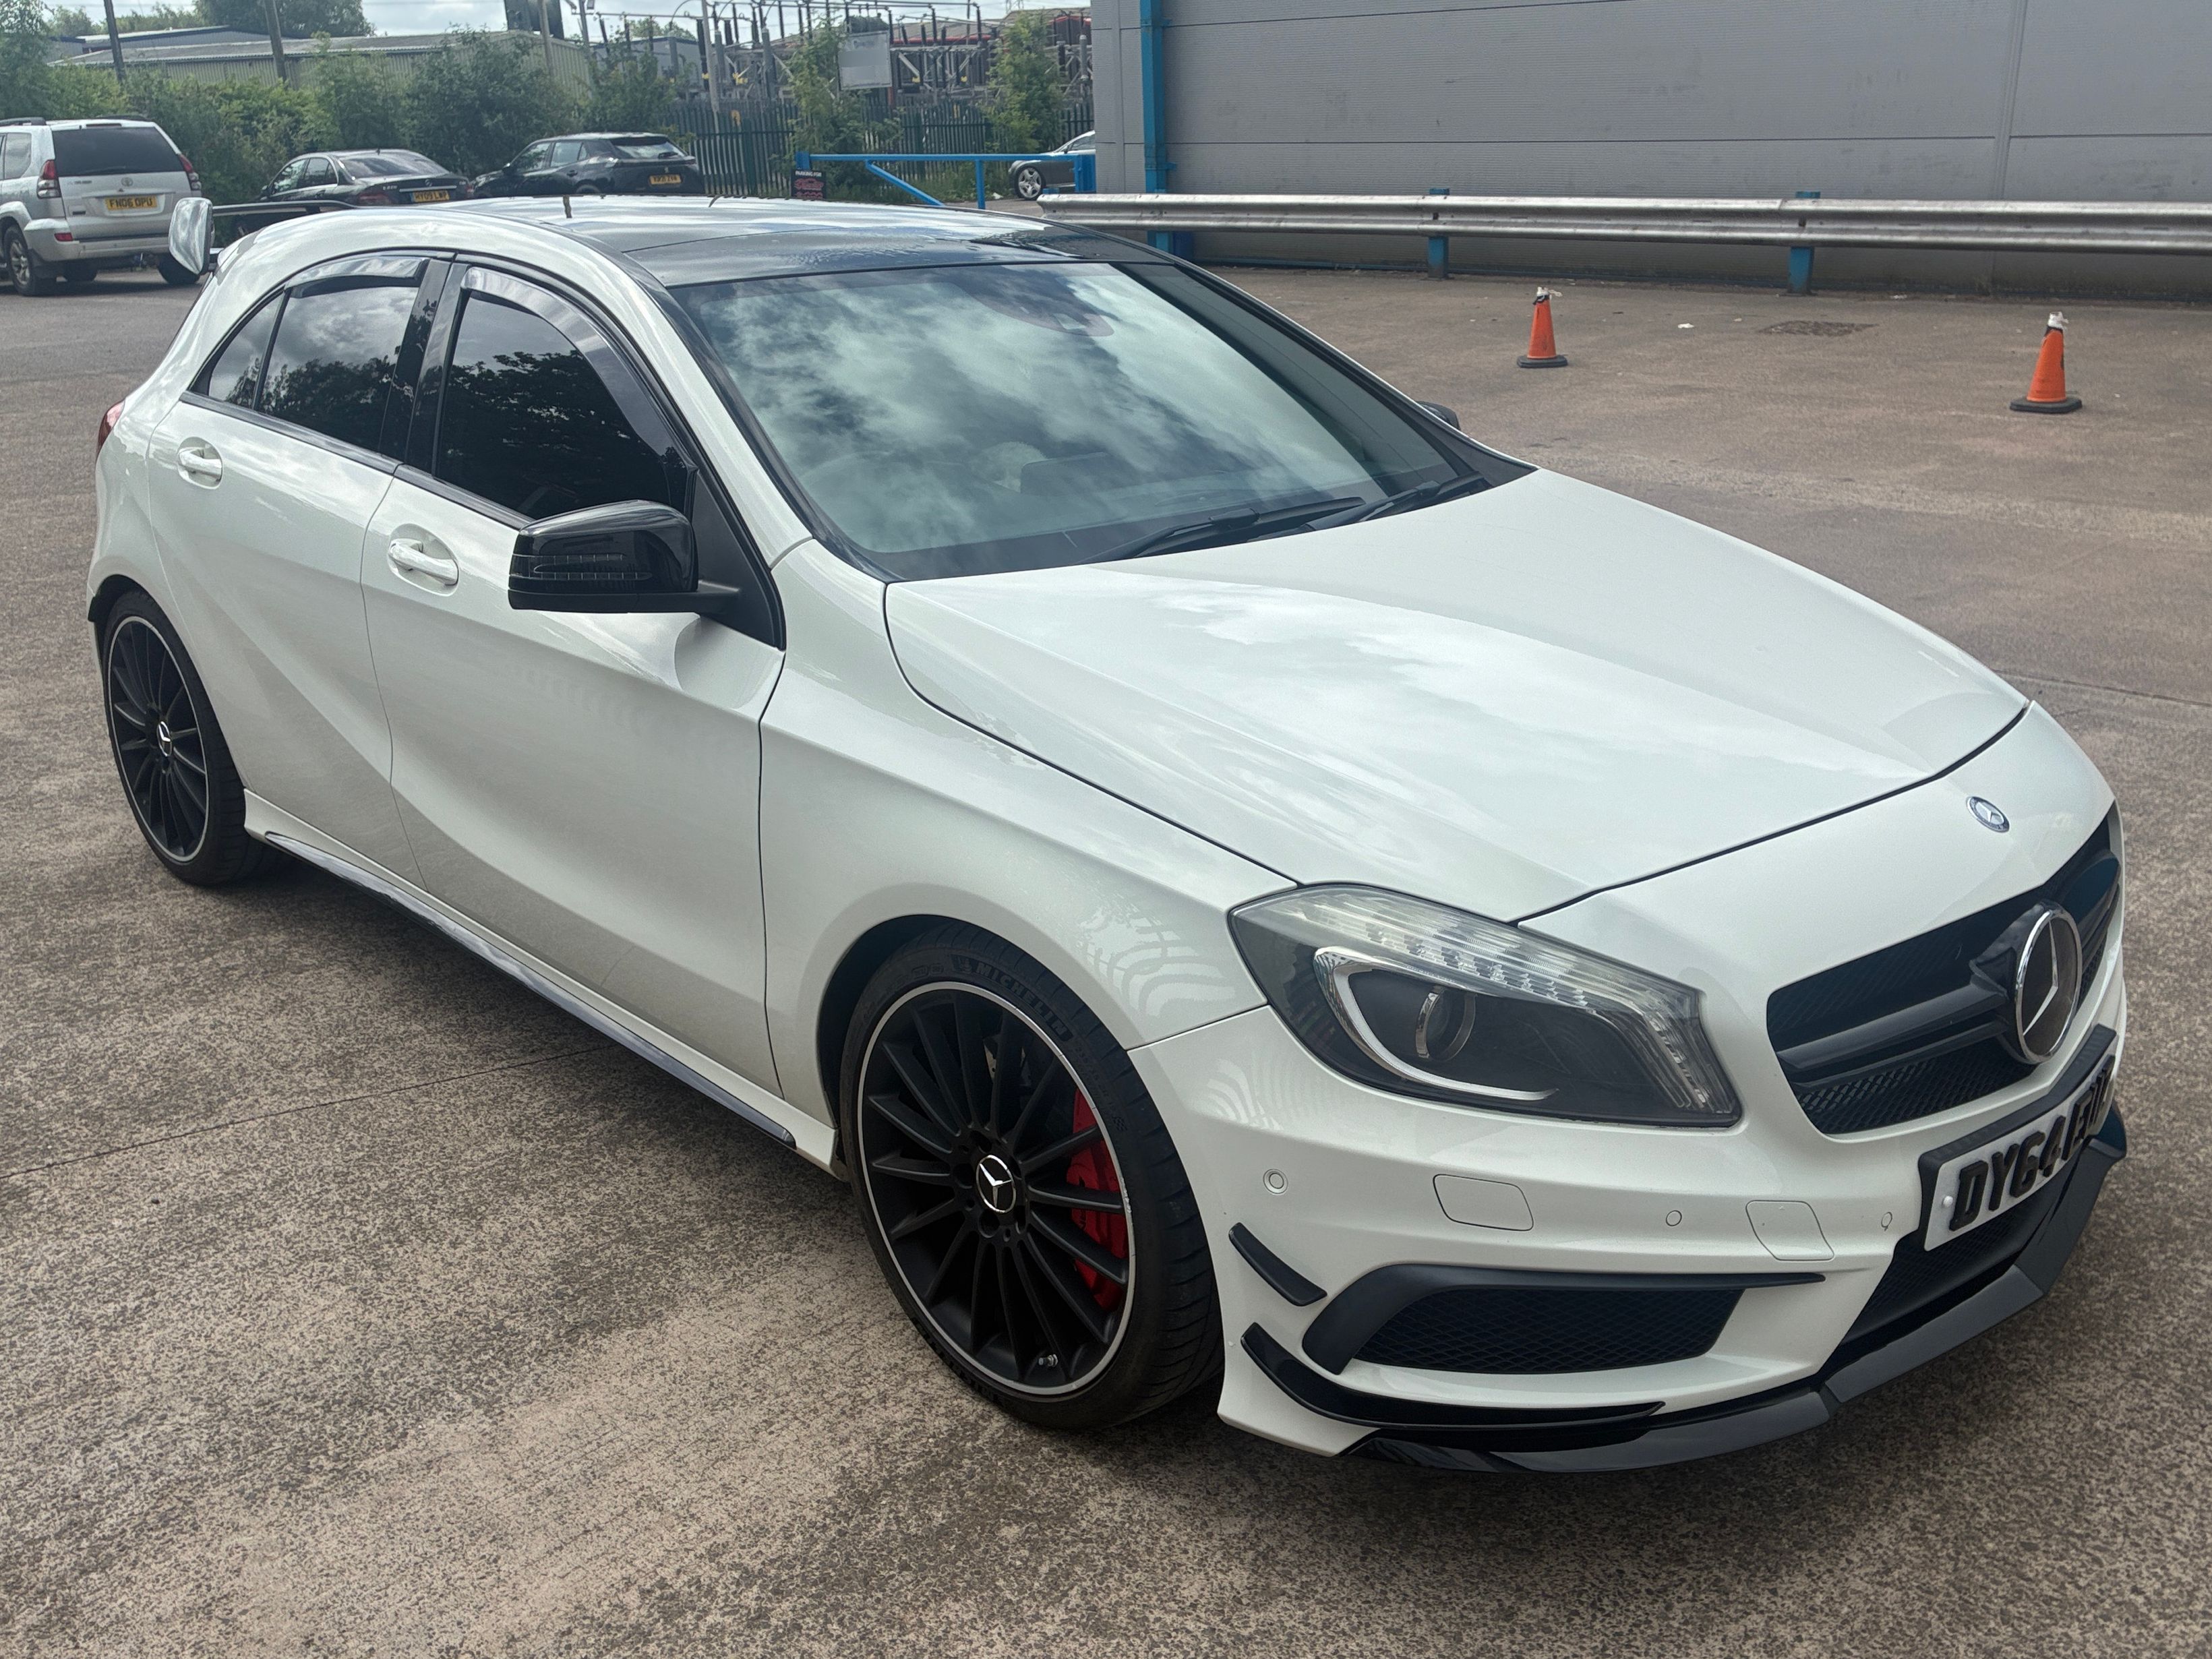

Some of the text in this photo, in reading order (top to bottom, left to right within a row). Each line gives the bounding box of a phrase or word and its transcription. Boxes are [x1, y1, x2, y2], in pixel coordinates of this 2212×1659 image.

[109, 198, 153, 208] FN06 OPU
[976, 962, 1067, 1035] MICHELIN
[1949, 1115, 2066, 1232] DY64
